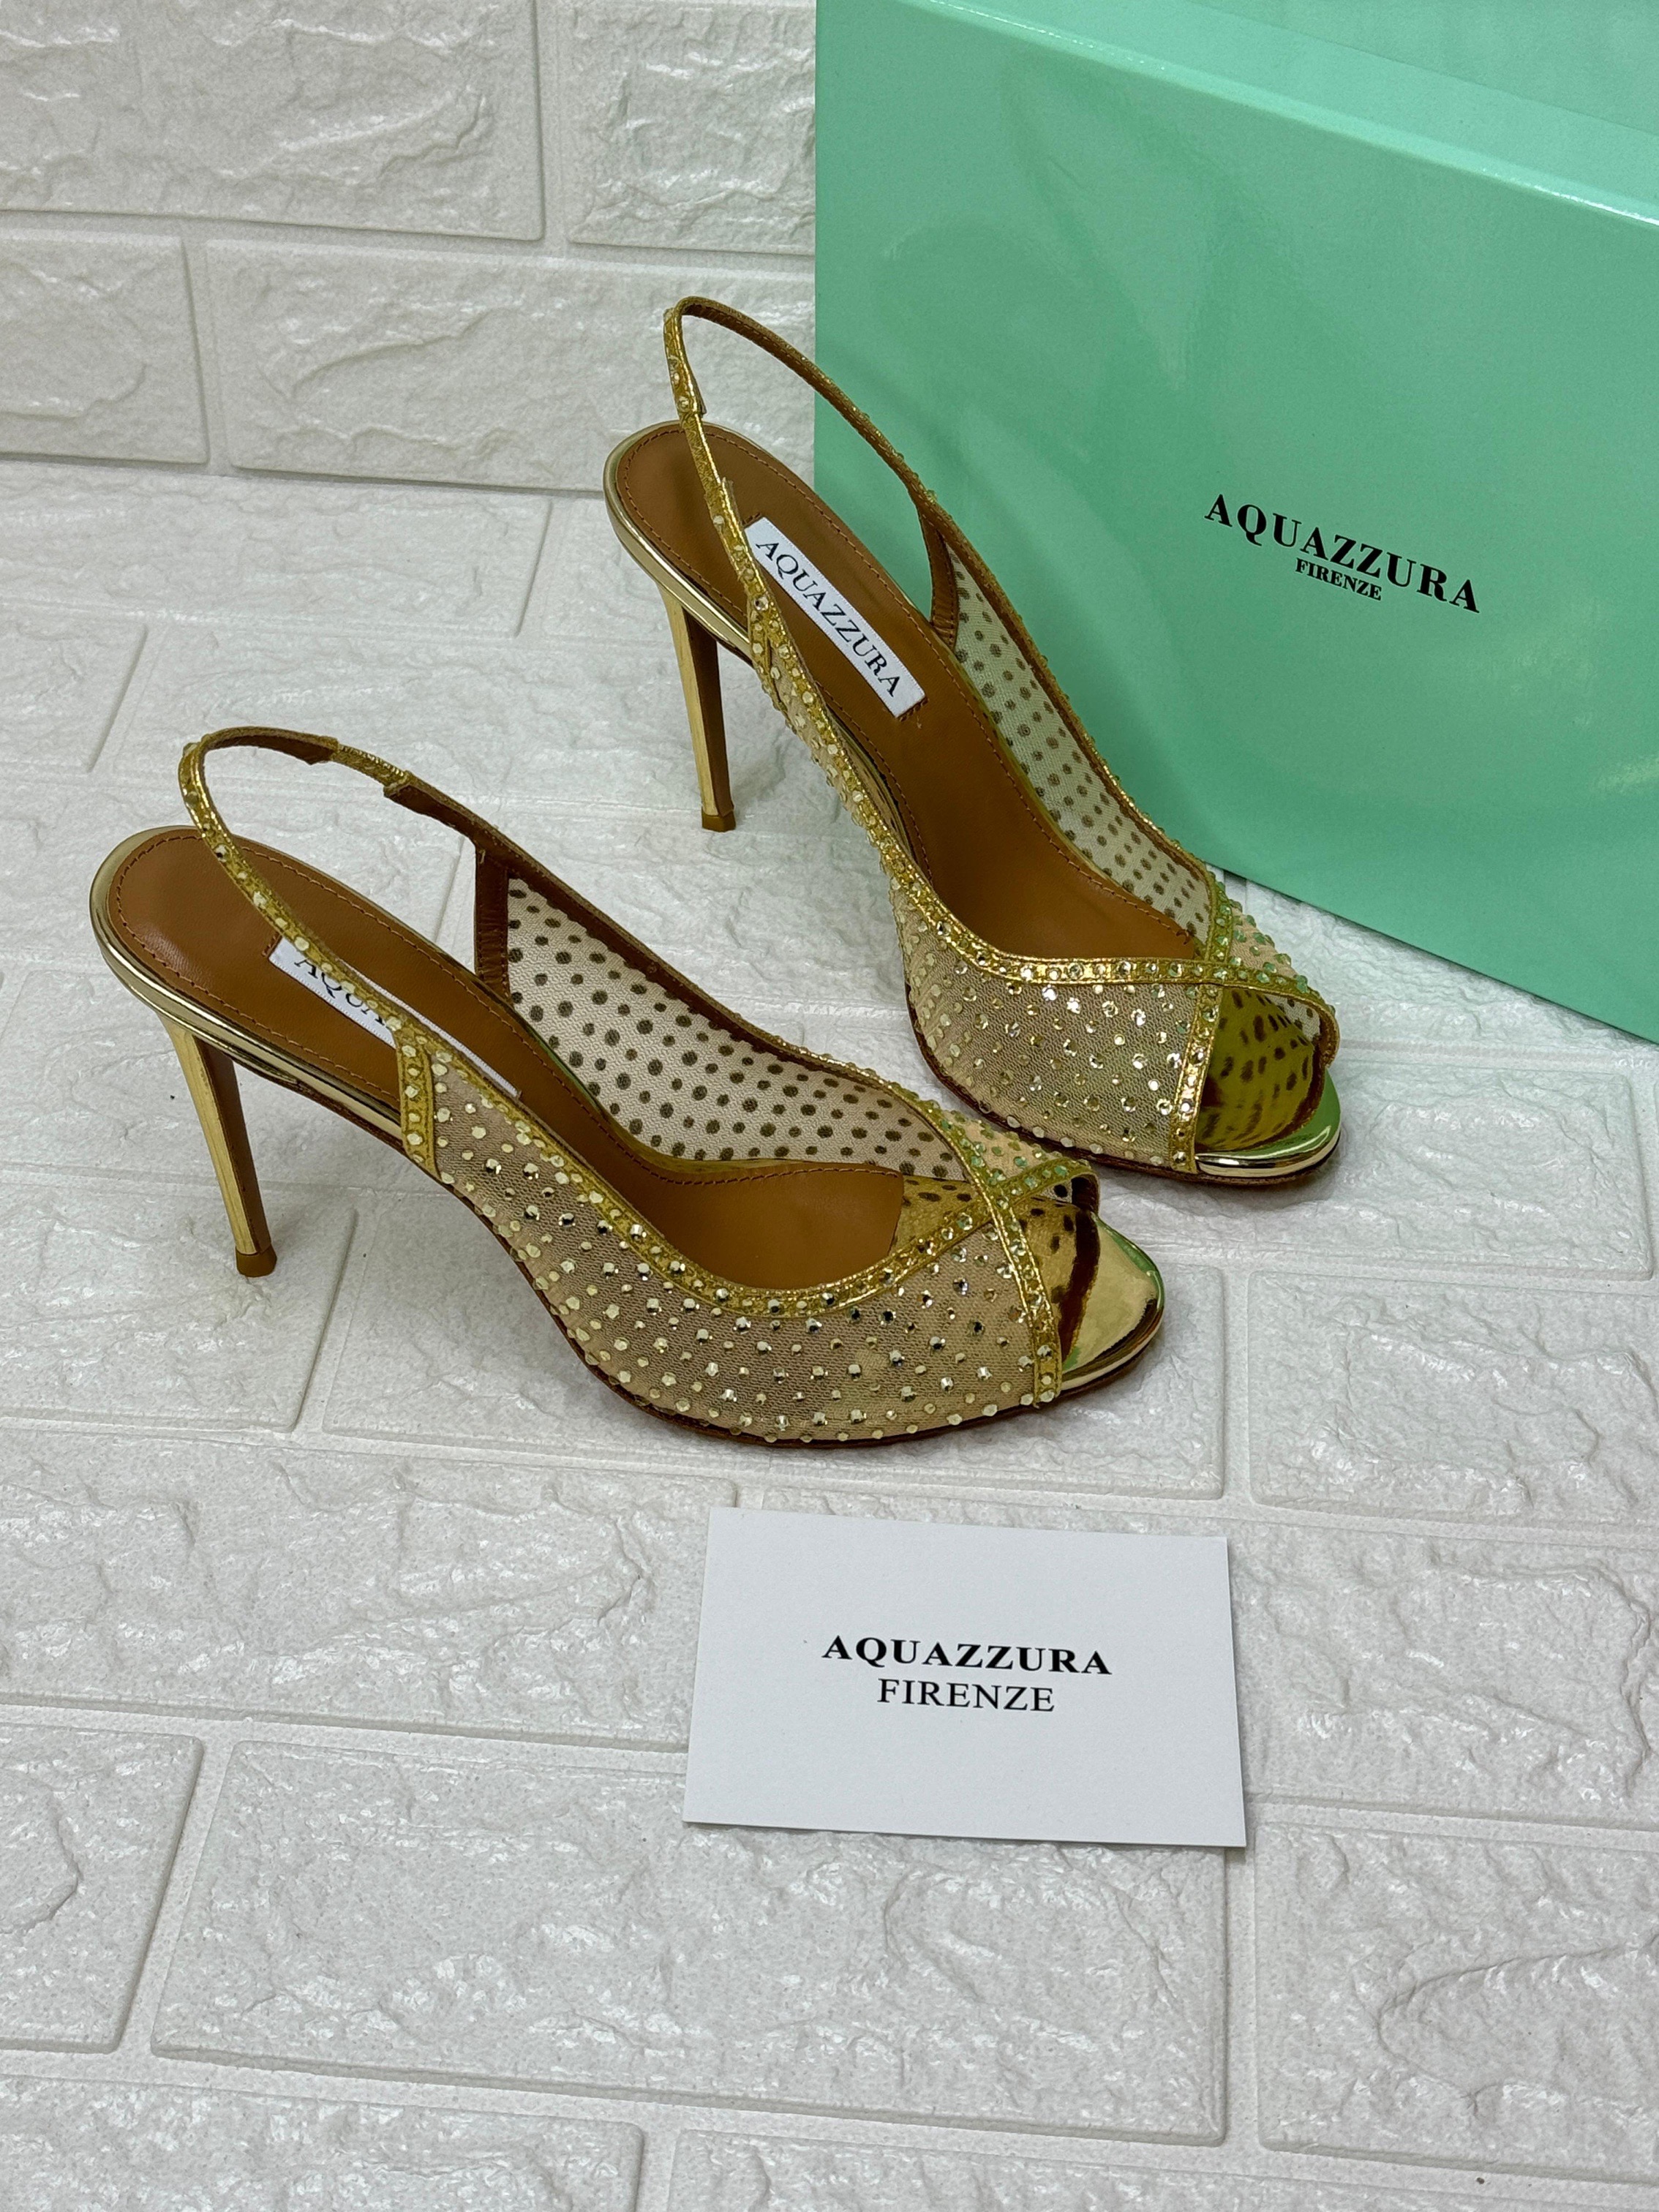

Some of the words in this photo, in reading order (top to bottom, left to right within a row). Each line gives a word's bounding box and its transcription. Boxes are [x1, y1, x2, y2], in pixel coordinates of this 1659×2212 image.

[1204, 494, 1480, 614] AQUAZZURA
[1295, 557, 1382, 601] FIRENZE
[756, 542, 900, 697] AQUAZZURA
[821, 1635, 1113, 1675] AQUAZZURA
[876, 1678, 1055, 1712] FIRENZE
